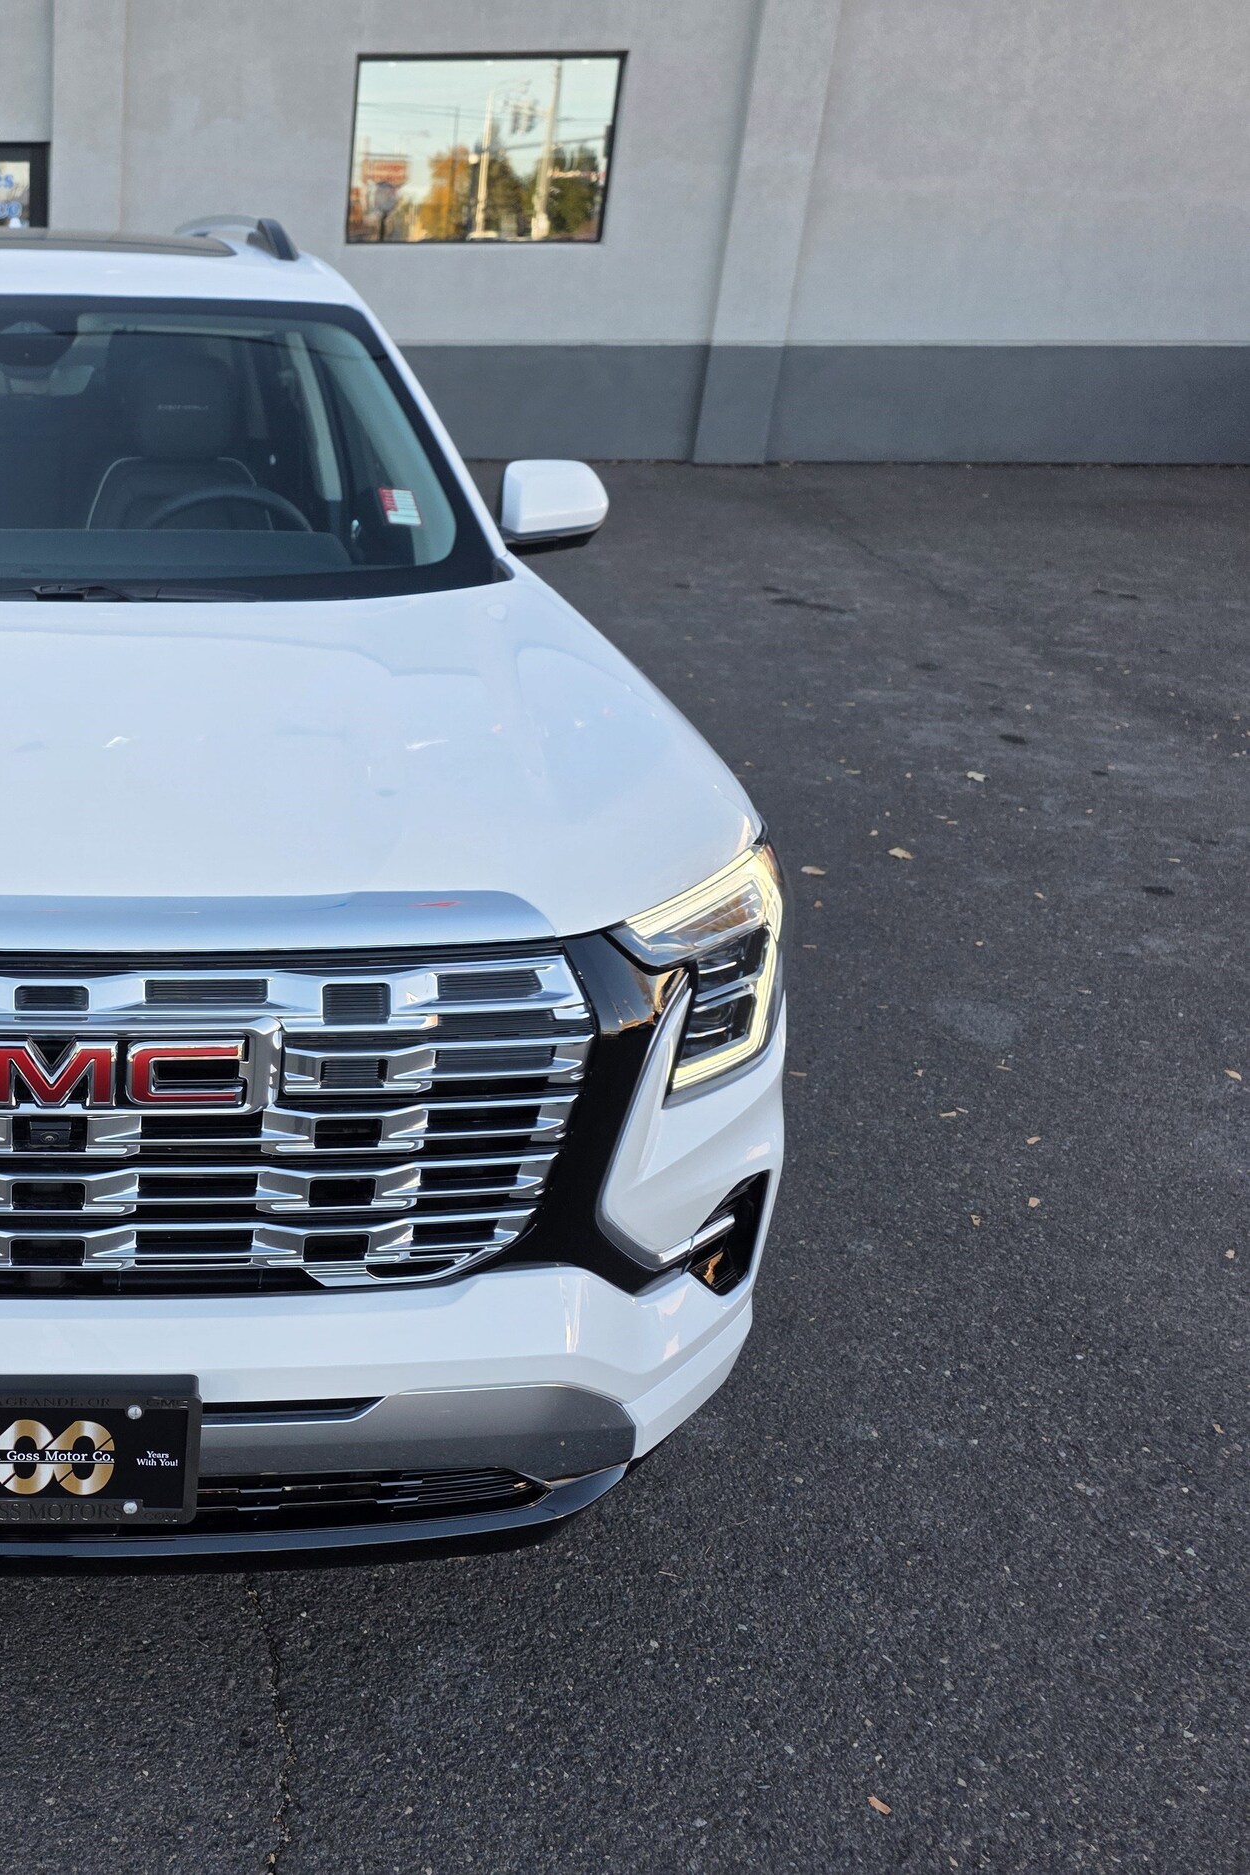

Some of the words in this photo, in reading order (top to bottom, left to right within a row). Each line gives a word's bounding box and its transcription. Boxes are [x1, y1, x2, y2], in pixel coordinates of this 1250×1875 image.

[6, 1450, 40, 1461] Goss
[44, 1451, 88, 1461] Motor
[92, 1451, 115, 1461] Co.
[146, 1451, 170, 1459] Years
[136, 1458, 157, 1467] With
[159, 1459, 179, 1467] You!
[27, 1503, 124, 1521] MOTORS
